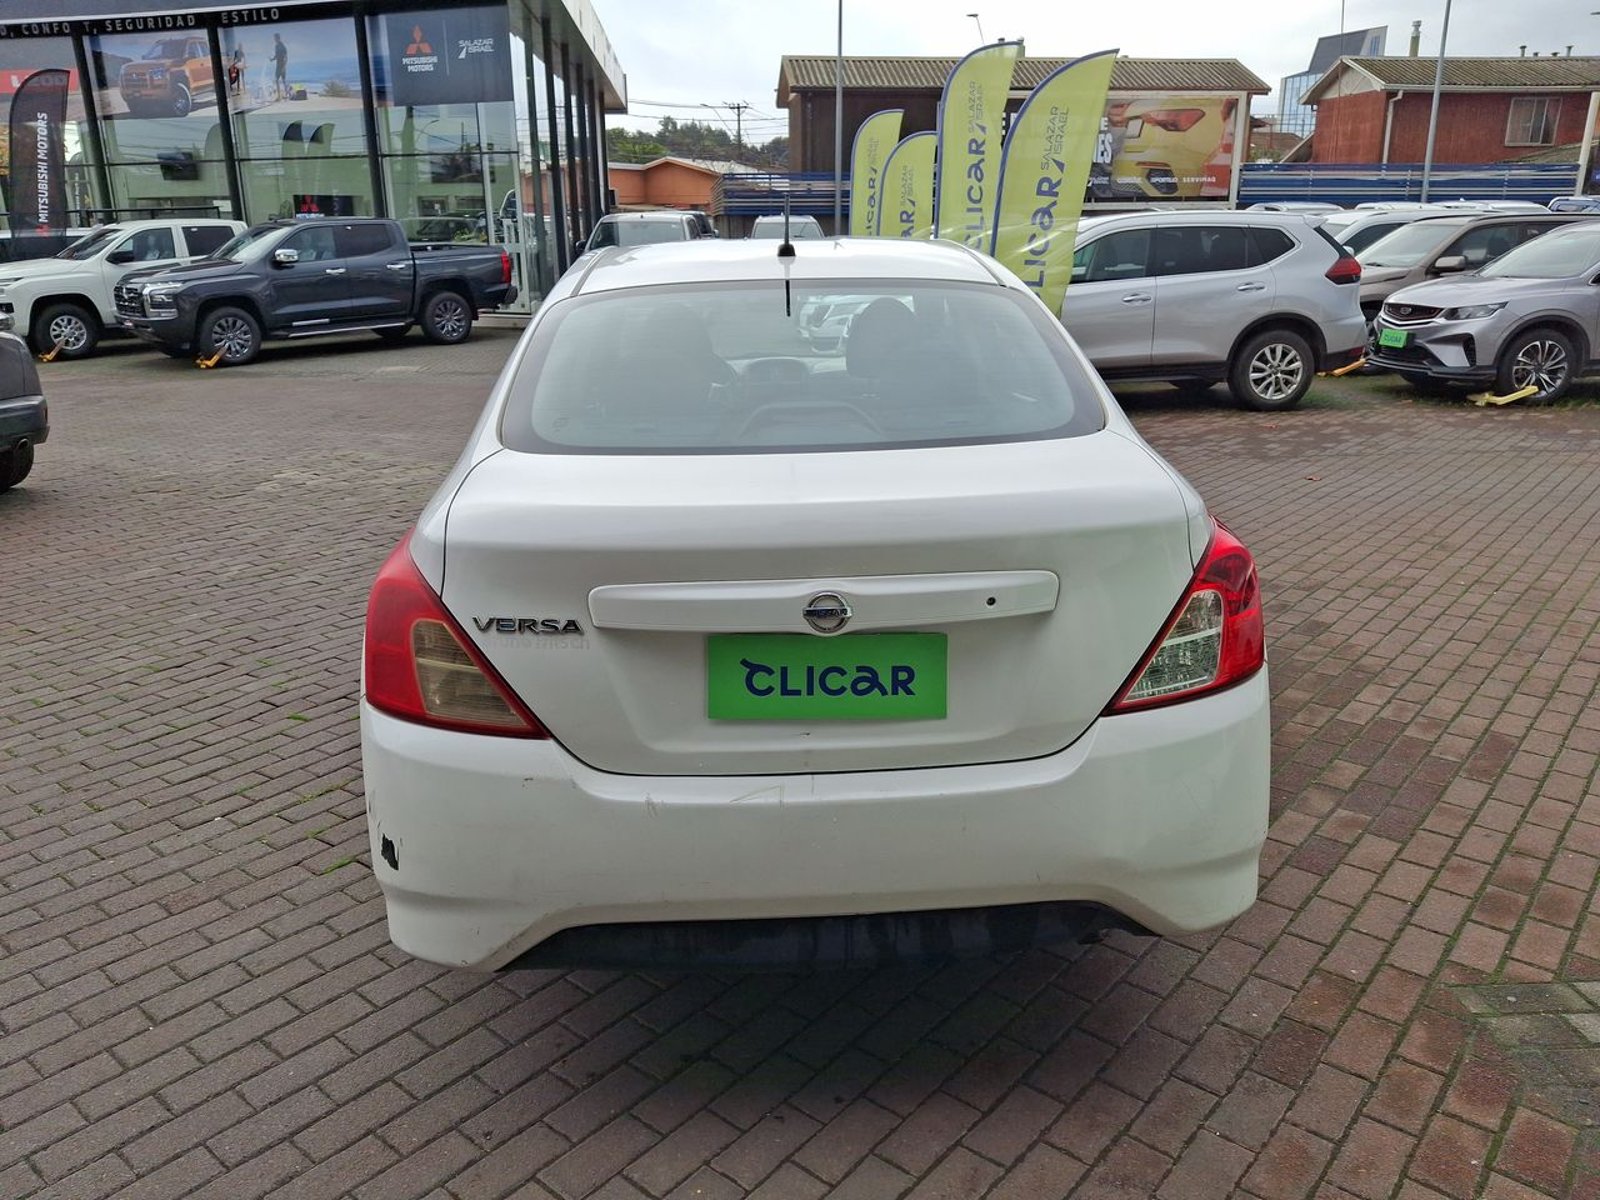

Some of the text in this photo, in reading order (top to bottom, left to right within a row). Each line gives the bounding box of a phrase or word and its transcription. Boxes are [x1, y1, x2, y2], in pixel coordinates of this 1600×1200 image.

[21, 21, 97, 35] CONFOT,
[105, 15, 195, 31] SEGURIDAD
[221, 8, 279, 23] ESTILO
[402, 55, 438, 65] MITSUBISHI
[407, 64, 434, 72] MOTORS
[1040, 105, 1059, 171] SALAZAR
[1053, 105, 1070, 155] ISRAEL
[37, 112, 49, 222] MITSUBISHI MOTORS
[1022, 176, 1063, 299] LICaR
[472, 616, 585, 636] VERSA
